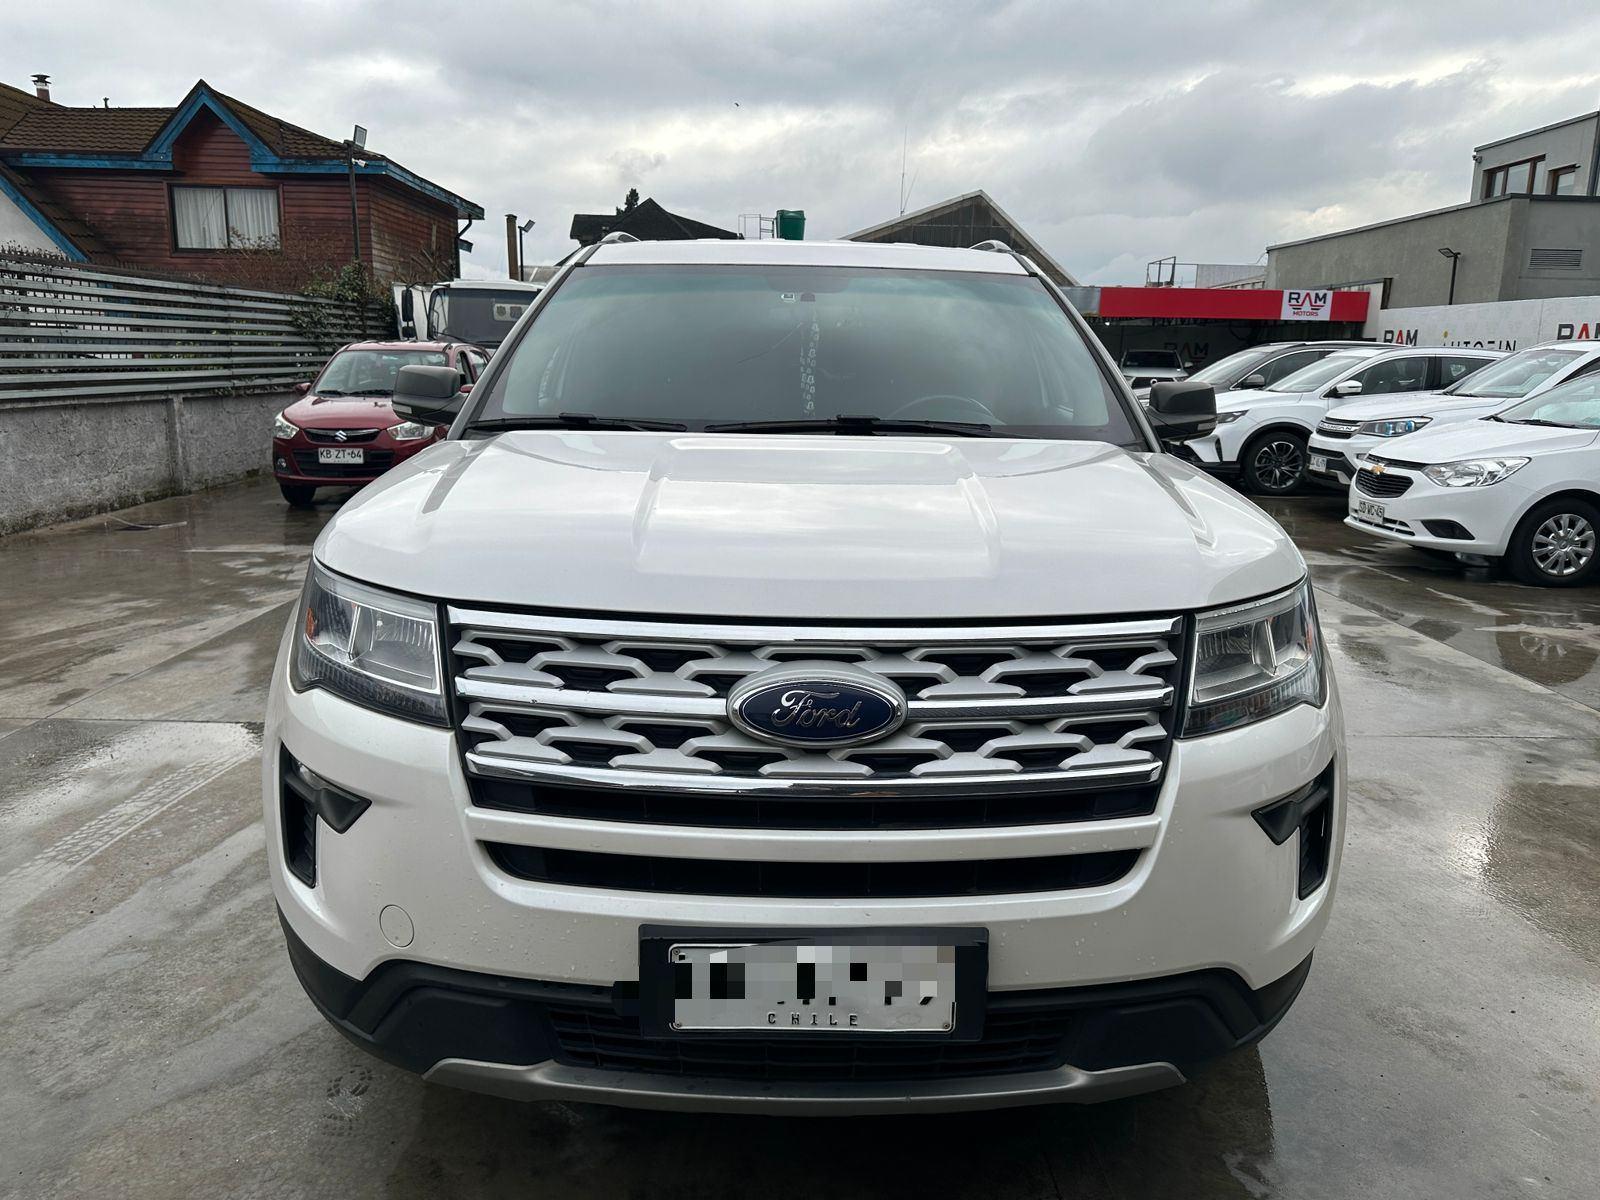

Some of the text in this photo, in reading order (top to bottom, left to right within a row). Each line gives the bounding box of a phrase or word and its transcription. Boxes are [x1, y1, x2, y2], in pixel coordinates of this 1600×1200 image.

[1288, 291, 1328, 305] RAM
[1383, 329, 1419, 346] RAM
[1557, 323, 1600, 341] RA
[771, 690, 862, 727] Ford
[767, 1012, 859, 1026] CHILE
